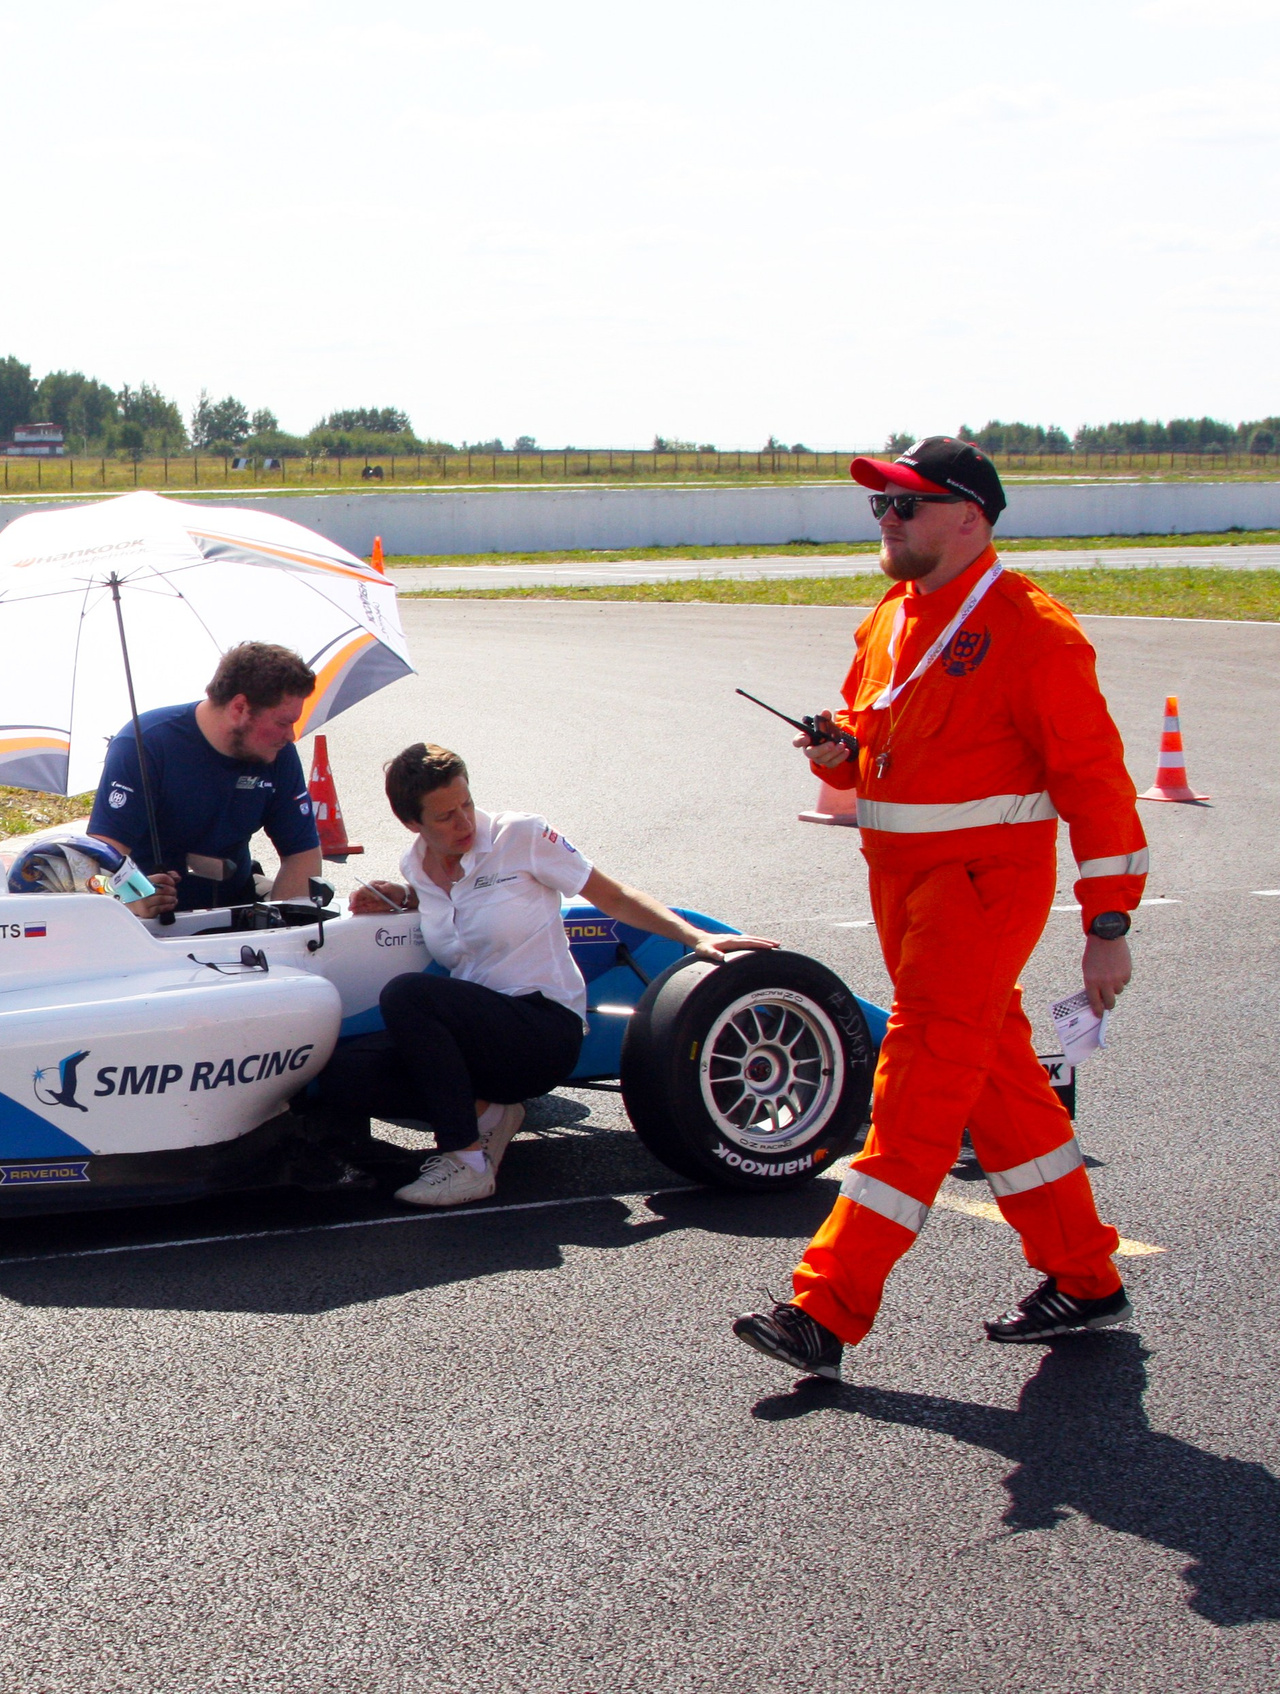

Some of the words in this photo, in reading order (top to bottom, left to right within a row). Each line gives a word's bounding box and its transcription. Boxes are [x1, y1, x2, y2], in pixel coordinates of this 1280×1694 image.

[93, 1064, 183, 1097] SMP
[189, 1044, 314, 1092] RACING
[10, 1168, 78, 1180] RAVENOL
